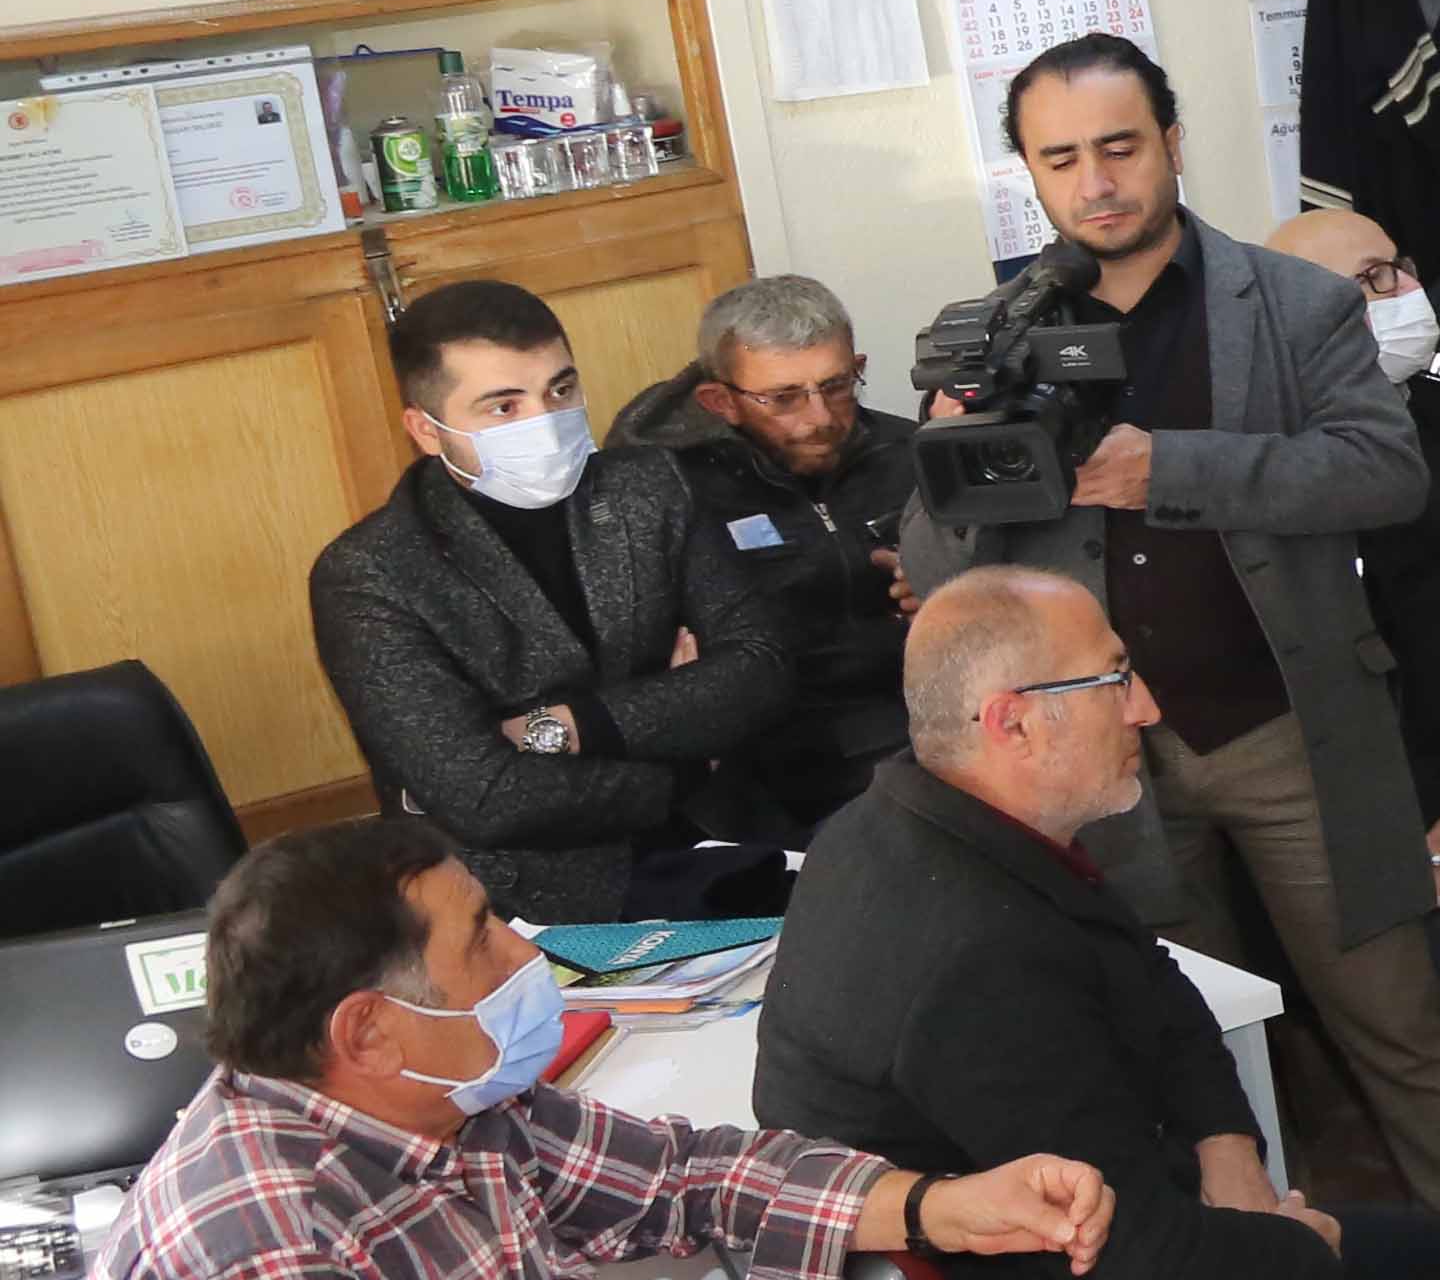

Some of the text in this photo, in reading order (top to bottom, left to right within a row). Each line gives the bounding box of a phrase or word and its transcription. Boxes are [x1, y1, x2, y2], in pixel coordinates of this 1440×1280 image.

[992, 44, 1008, 55] 25
[1017, 40, 1032, 51] 26
[495, 89, 575, 112] Tempa
[1024, 210, 1038, 221] 13
[1026, 224, 1041, 234] 20
[1058, 344, 1089, 358] 4K
